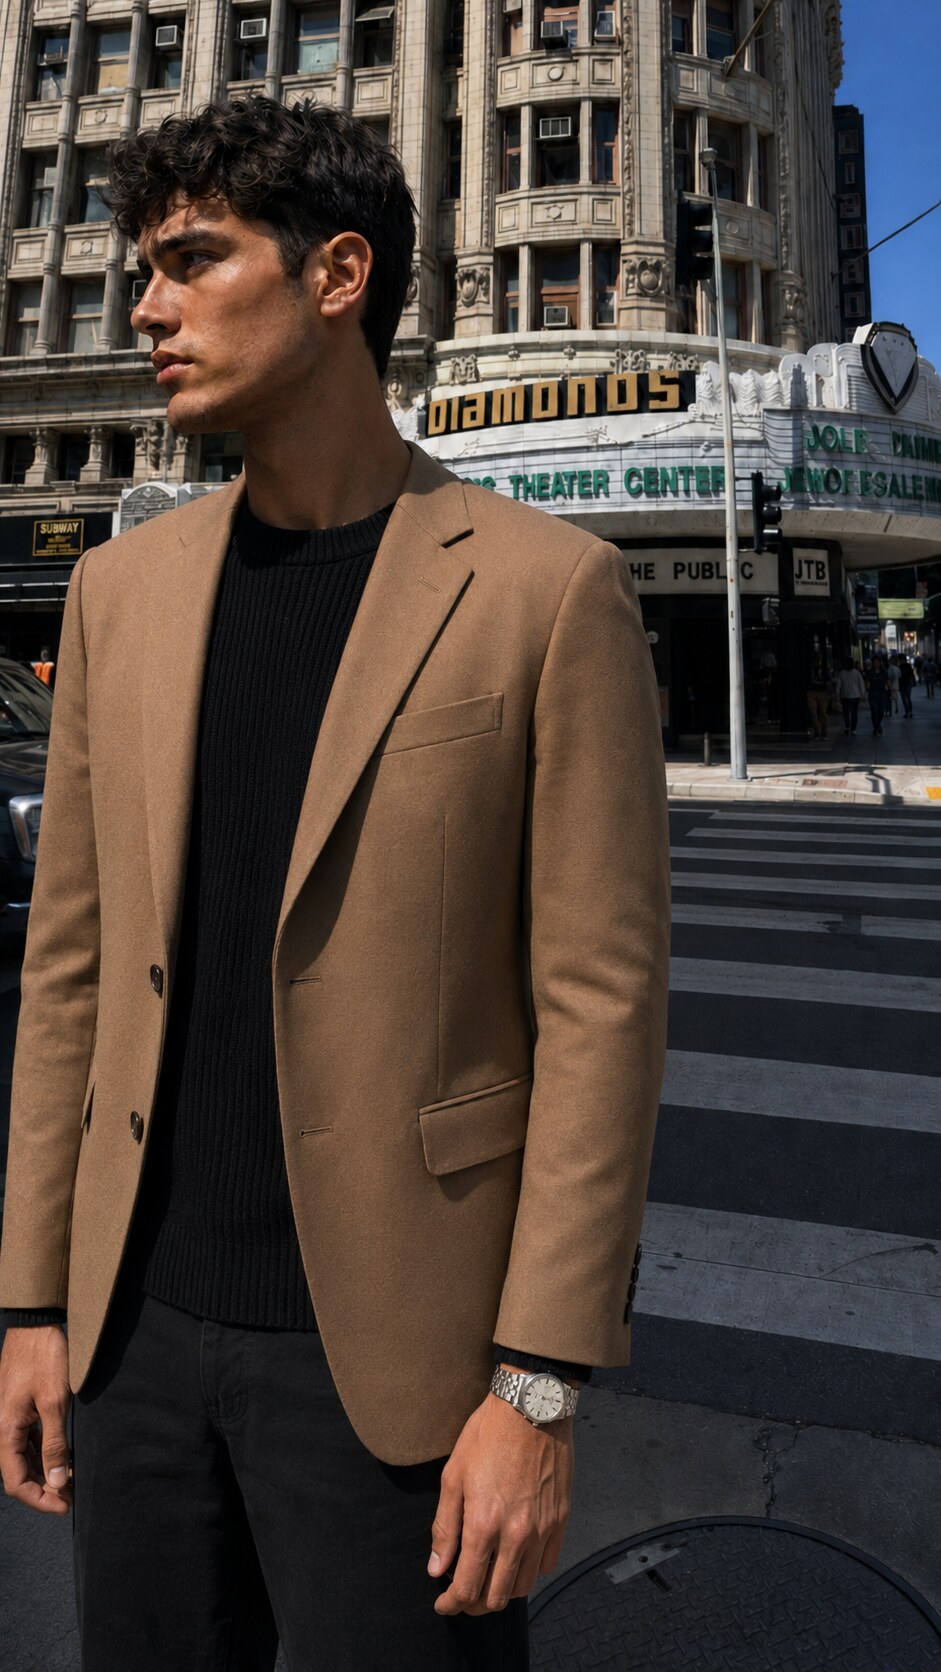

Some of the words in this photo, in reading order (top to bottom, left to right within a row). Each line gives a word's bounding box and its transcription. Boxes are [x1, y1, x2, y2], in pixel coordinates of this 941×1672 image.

[508, 469, 610, 500] THEATER
[624, 466, 725, 495] CENTER
[40, 522, 79, 534] SUBWAY
[673, 562, 754, 580] PUBLC
[795, 559, 826, 580] JTB
